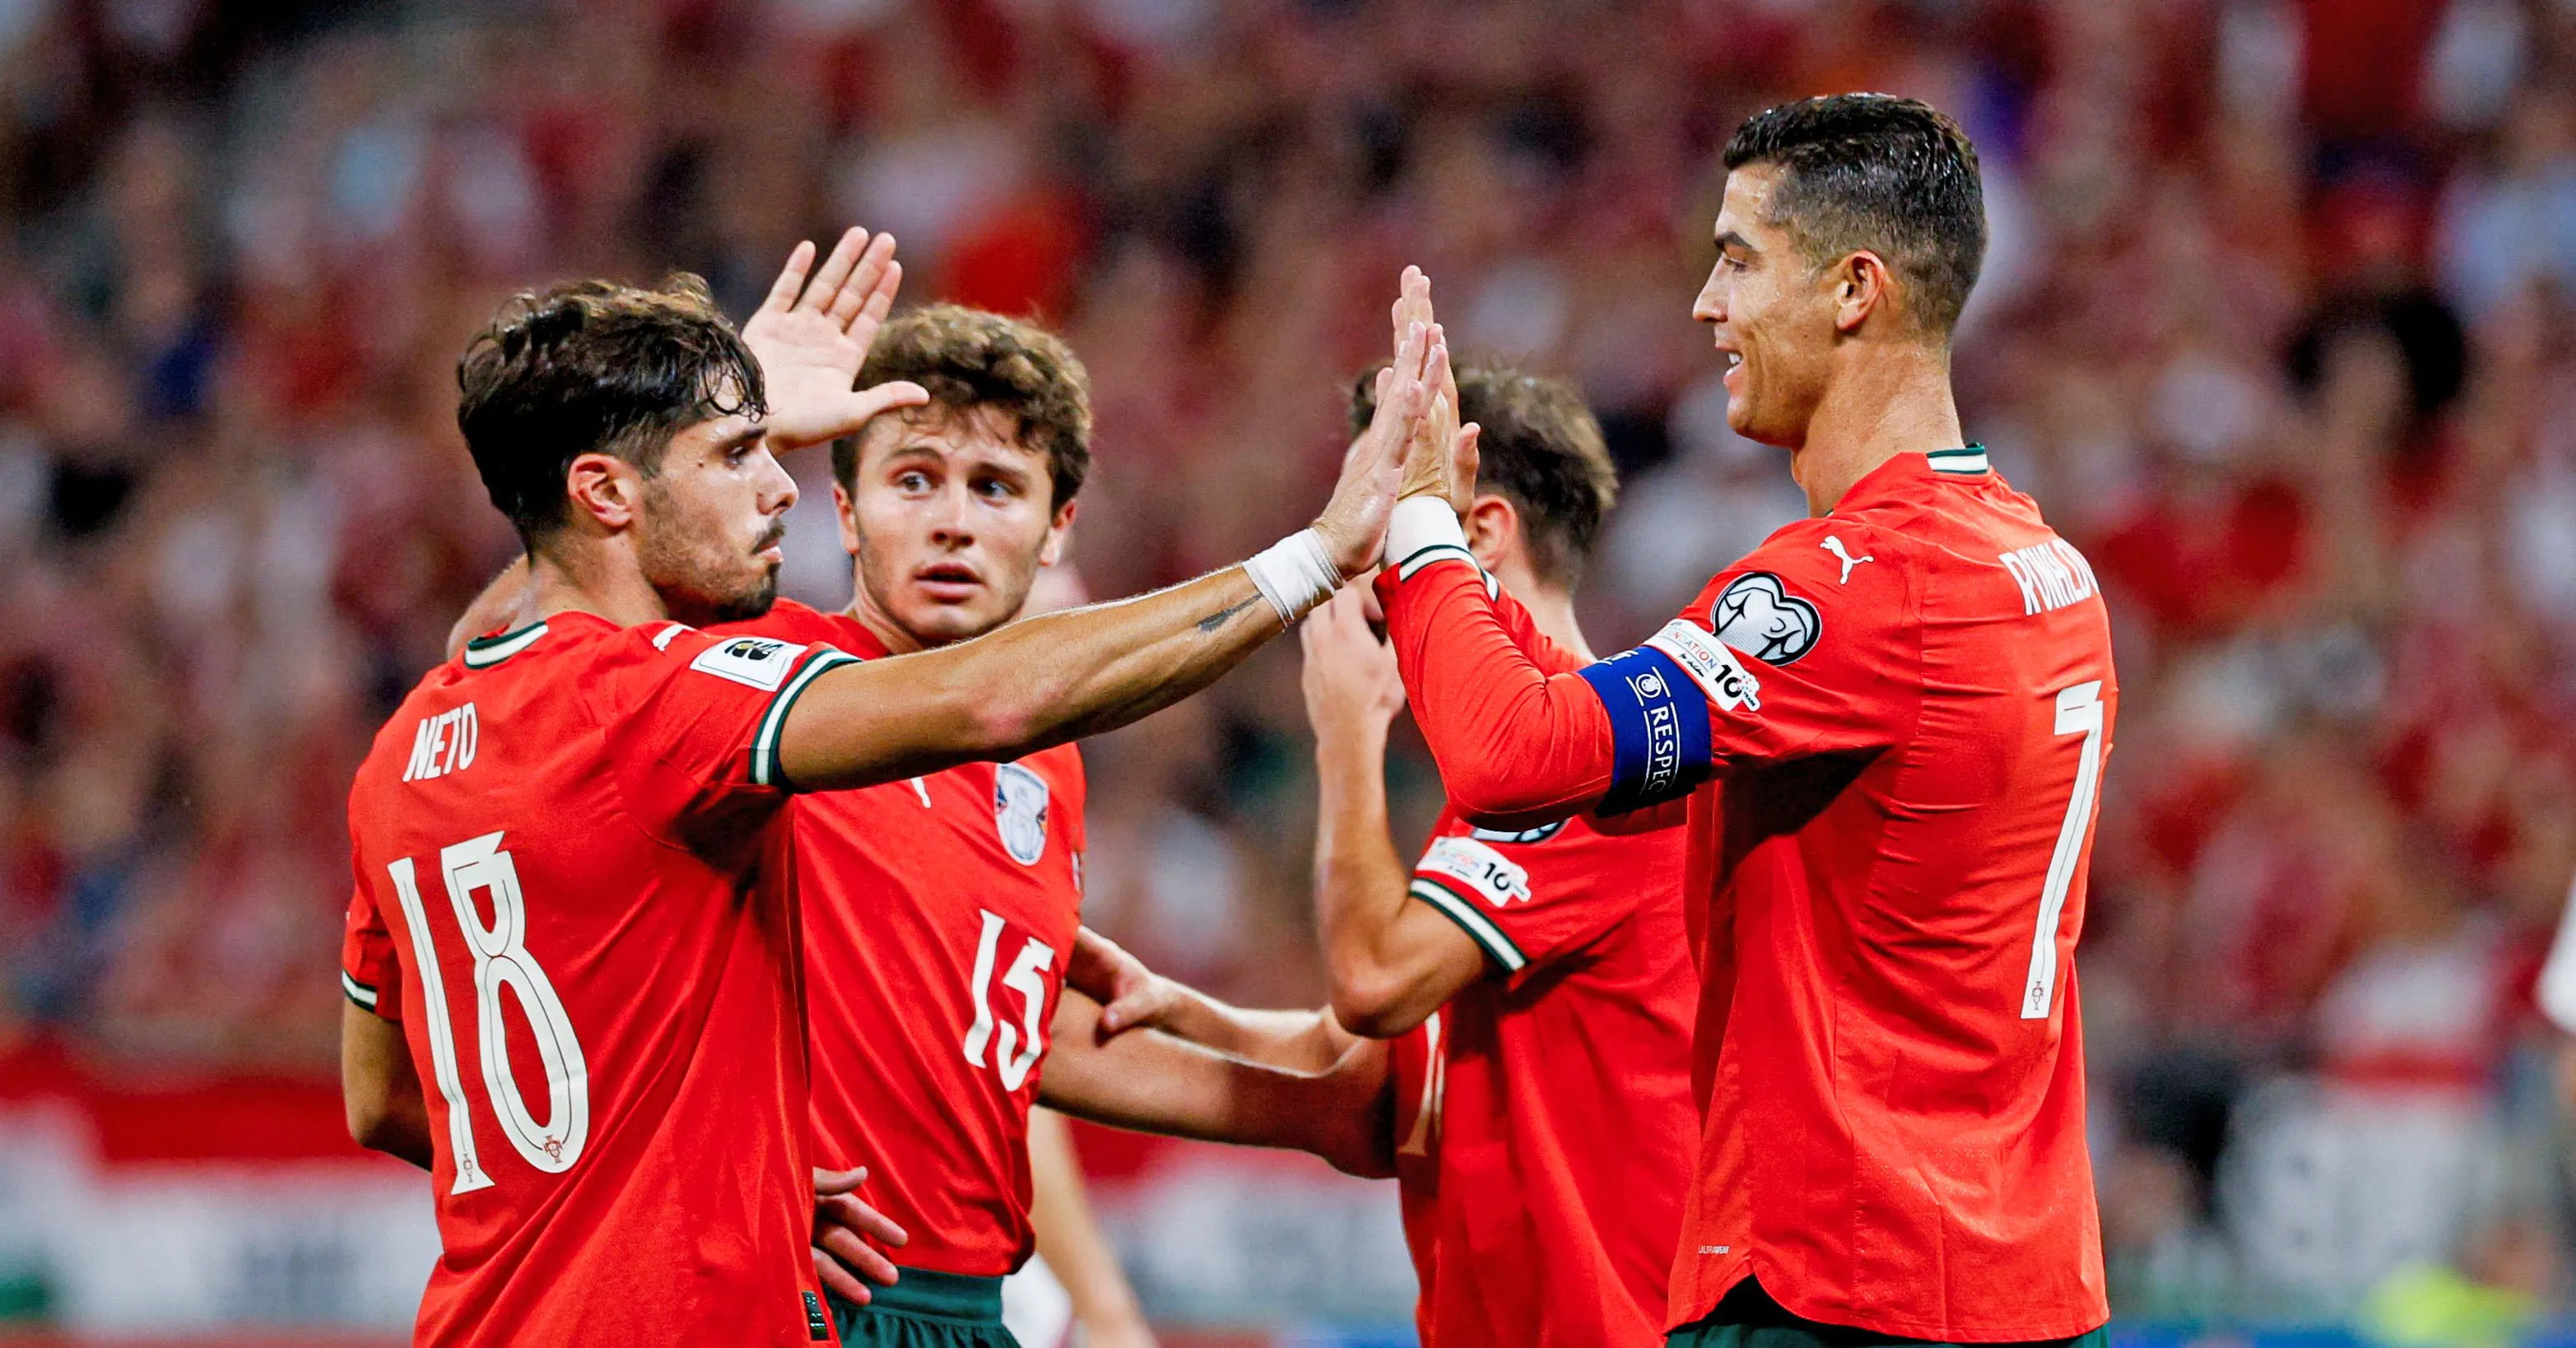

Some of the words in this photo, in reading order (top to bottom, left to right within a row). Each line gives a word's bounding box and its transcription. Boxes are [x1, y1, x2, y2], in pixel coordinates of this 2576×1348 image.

[1714, 664, 1743, 698] 10
[402, 701, 478, 783] NETO
[1648, 706, 1673, 793] RESPEC
[1484, 862, 1510, 891] 10
[2020, 680, 2104, 1020] 7
[388, 830, 588, 1195] 18
[963, 908, 1055, 1092] 15
